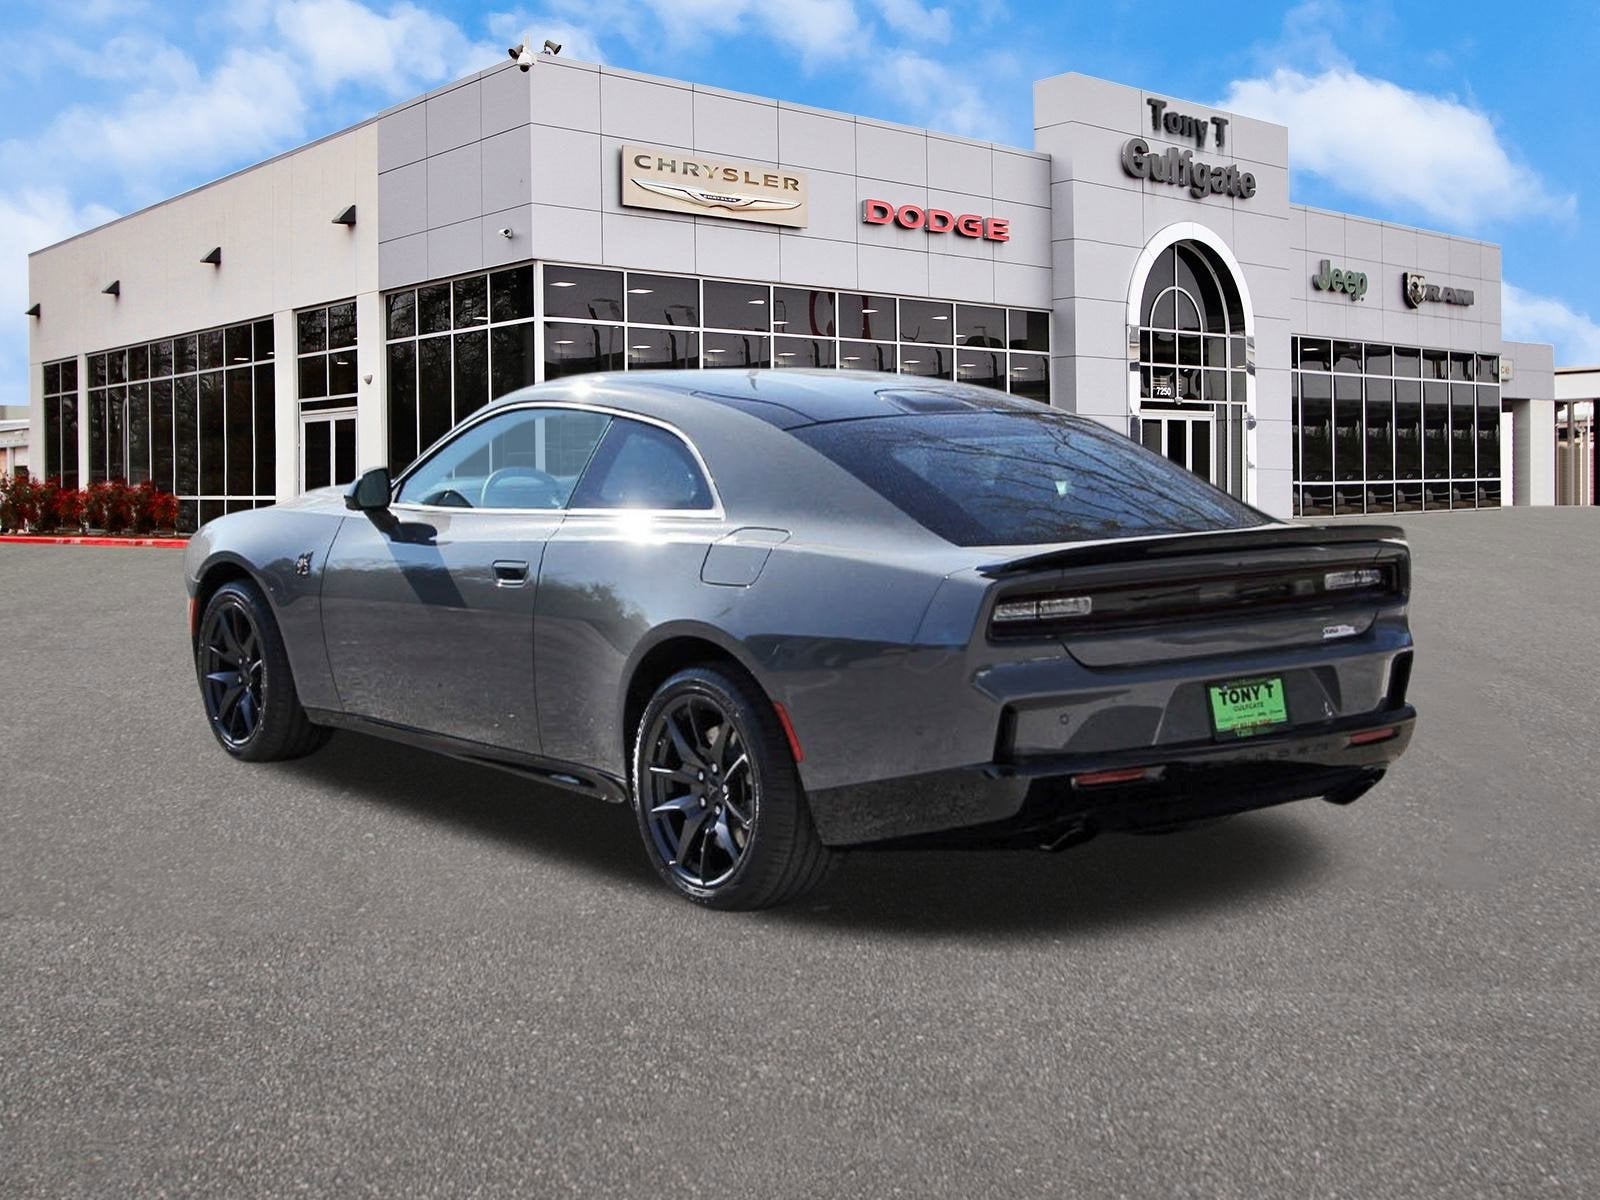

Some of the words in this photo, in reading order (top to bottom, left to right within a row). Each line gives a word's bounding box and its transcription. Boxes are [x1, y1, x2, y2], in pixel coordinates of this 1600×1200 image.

[1146, 98, 1208, 148] Tony
[1210, 116, 1229, 147] T
[633, 154, 800, 191] CHRYSLER
[1121, 137, 1256, 199] Gulfgate
[862, 198, 1010, 242] DODGE
[1312, 259, 1368, 301] Jeep
[1425, 283, 1474, 306] RAM
[1218, 686, 1261, 706] TONY
[1265, 683, 1274, 698] T
